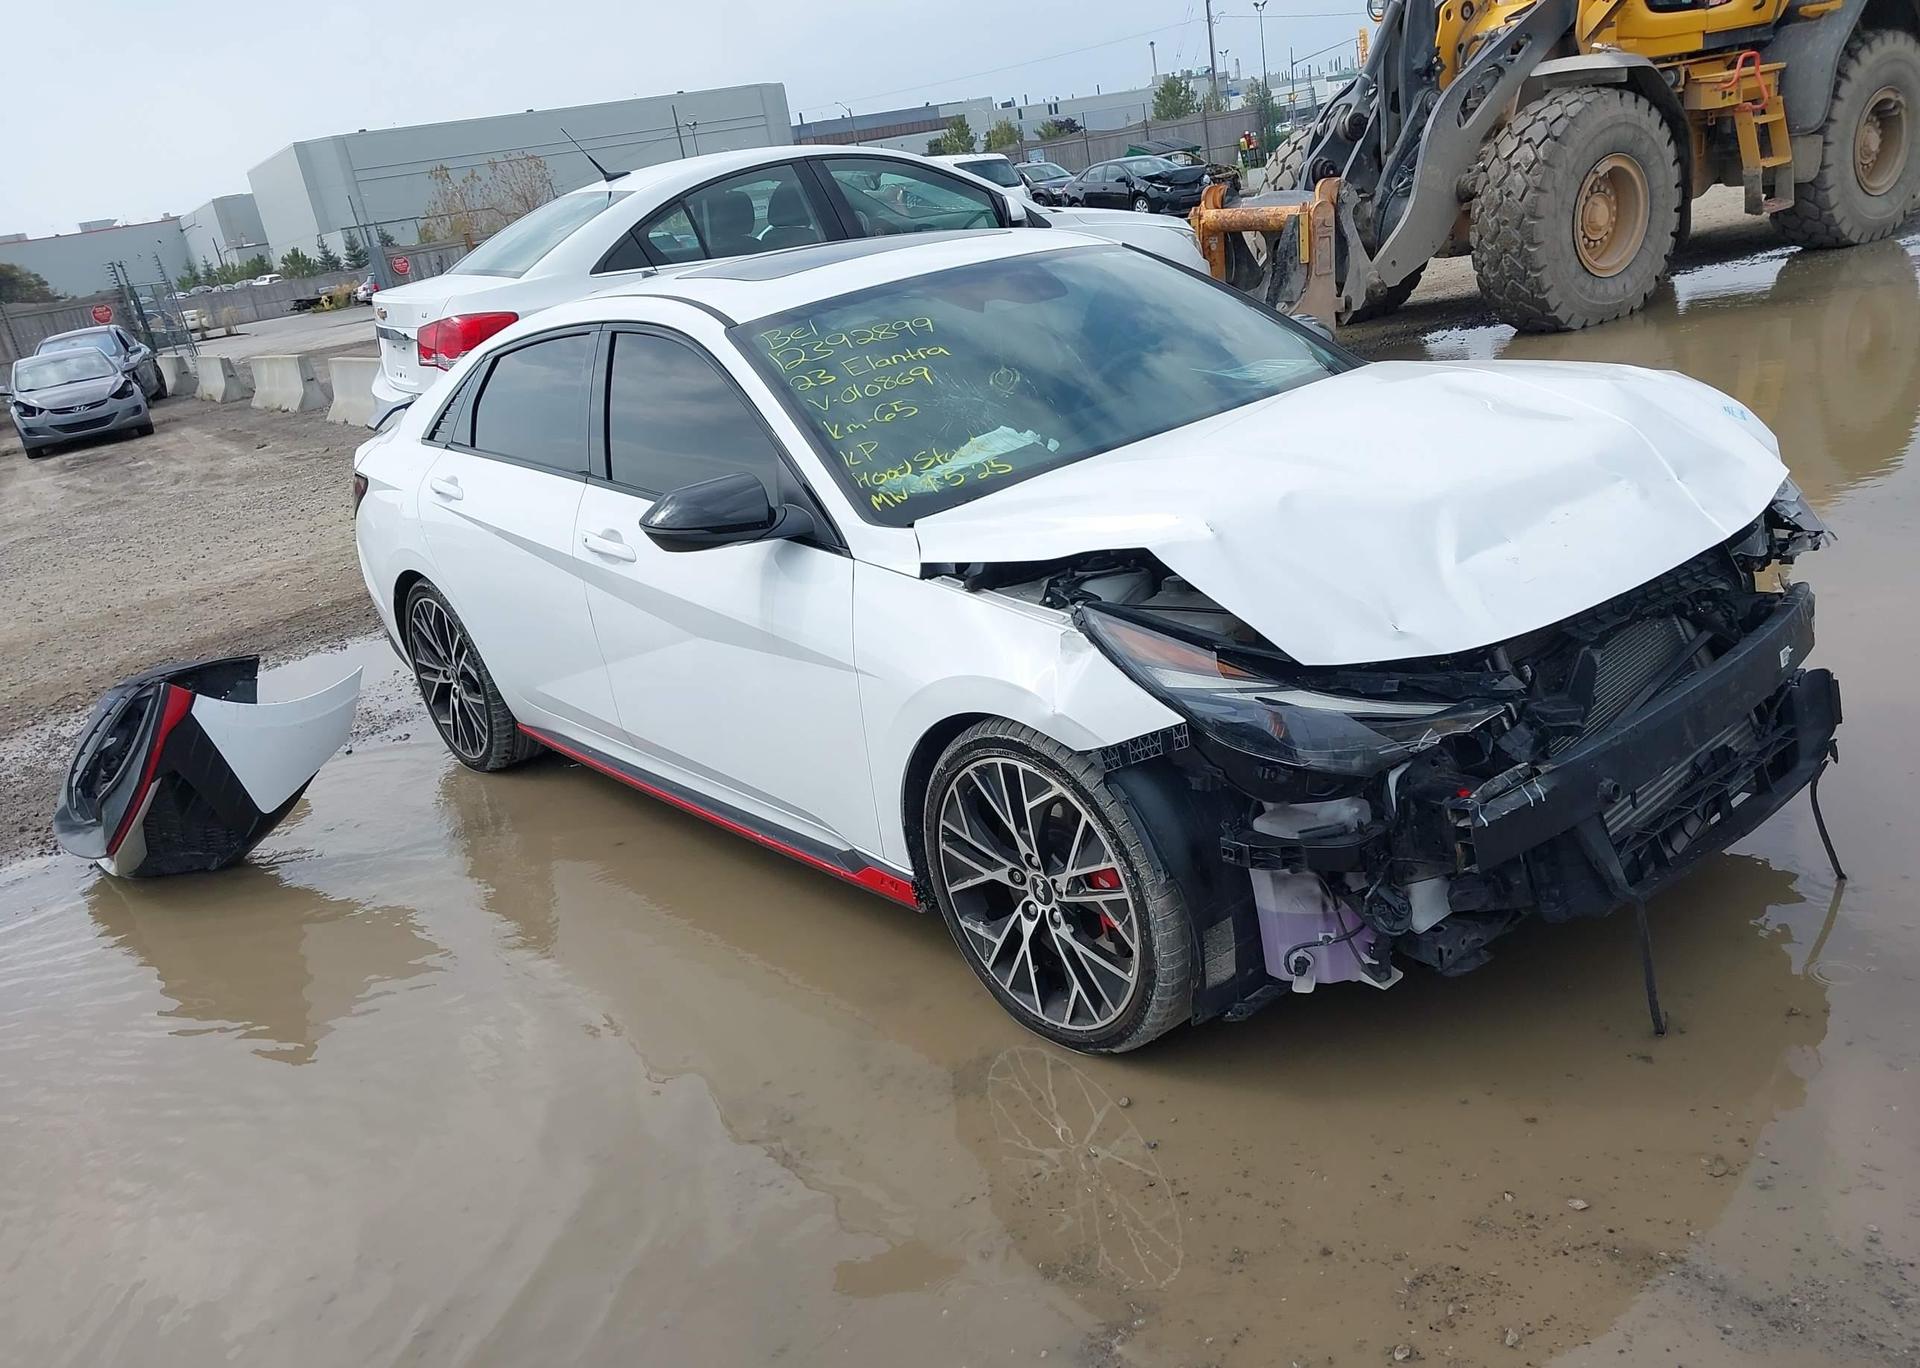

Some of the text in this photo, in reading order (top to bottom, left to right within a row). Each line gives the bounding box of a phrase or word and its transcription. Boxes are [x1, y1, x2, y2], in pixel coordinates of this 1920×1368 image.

[768, 318, 934, 373] 12392899
[789, 347, 951, 390] 23 Elantra
